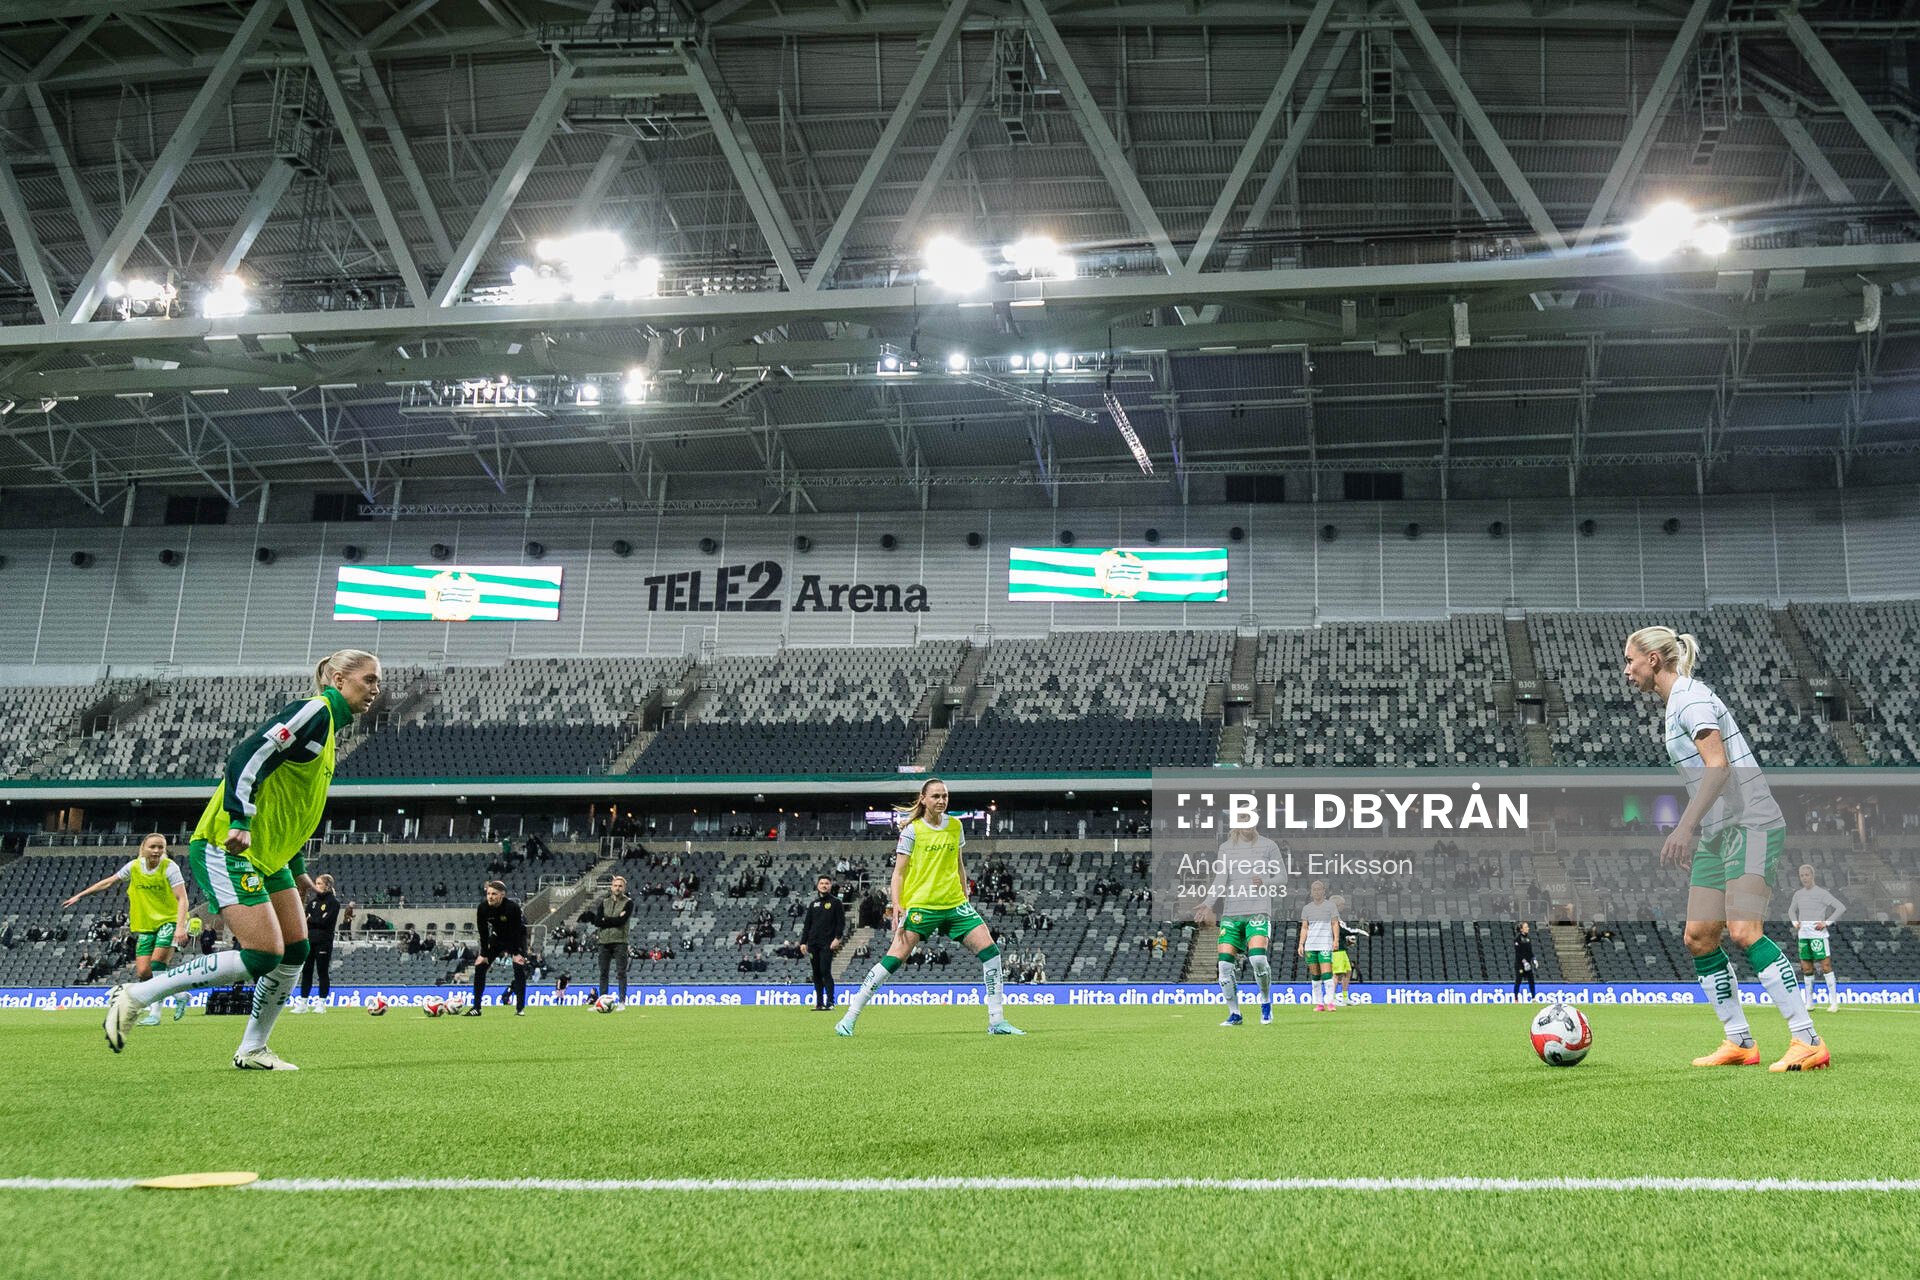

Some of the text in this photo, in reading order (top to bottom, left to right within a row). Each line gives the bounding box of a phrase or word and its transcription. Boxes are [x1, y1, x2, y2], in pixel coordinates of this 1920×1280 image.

[644, 560, 931, 613] TELE2 Arena
[0, 992, 33, 1008] tad
[35, 991, 57, 1008] på
[338, 990, 361, 1007] på
[645, 989, 668, 1006] på
[671, 990, 741, 1006] obos.se
[756, 989, 800, 1005] Hitta
[957, 988, 980, 1005] på
[1069, 989, 1115, 1005] Hitta
[1119, 989, 1148, 1005] din
[1272, 987, 1296, 1004] på
[1386, 988, 1433, 1004] Hitta
[1437, 988, 1466, 1004] din
[1593, 986, 1618, 1003] på
[1620, 988, 1694, 1003] obos.se
